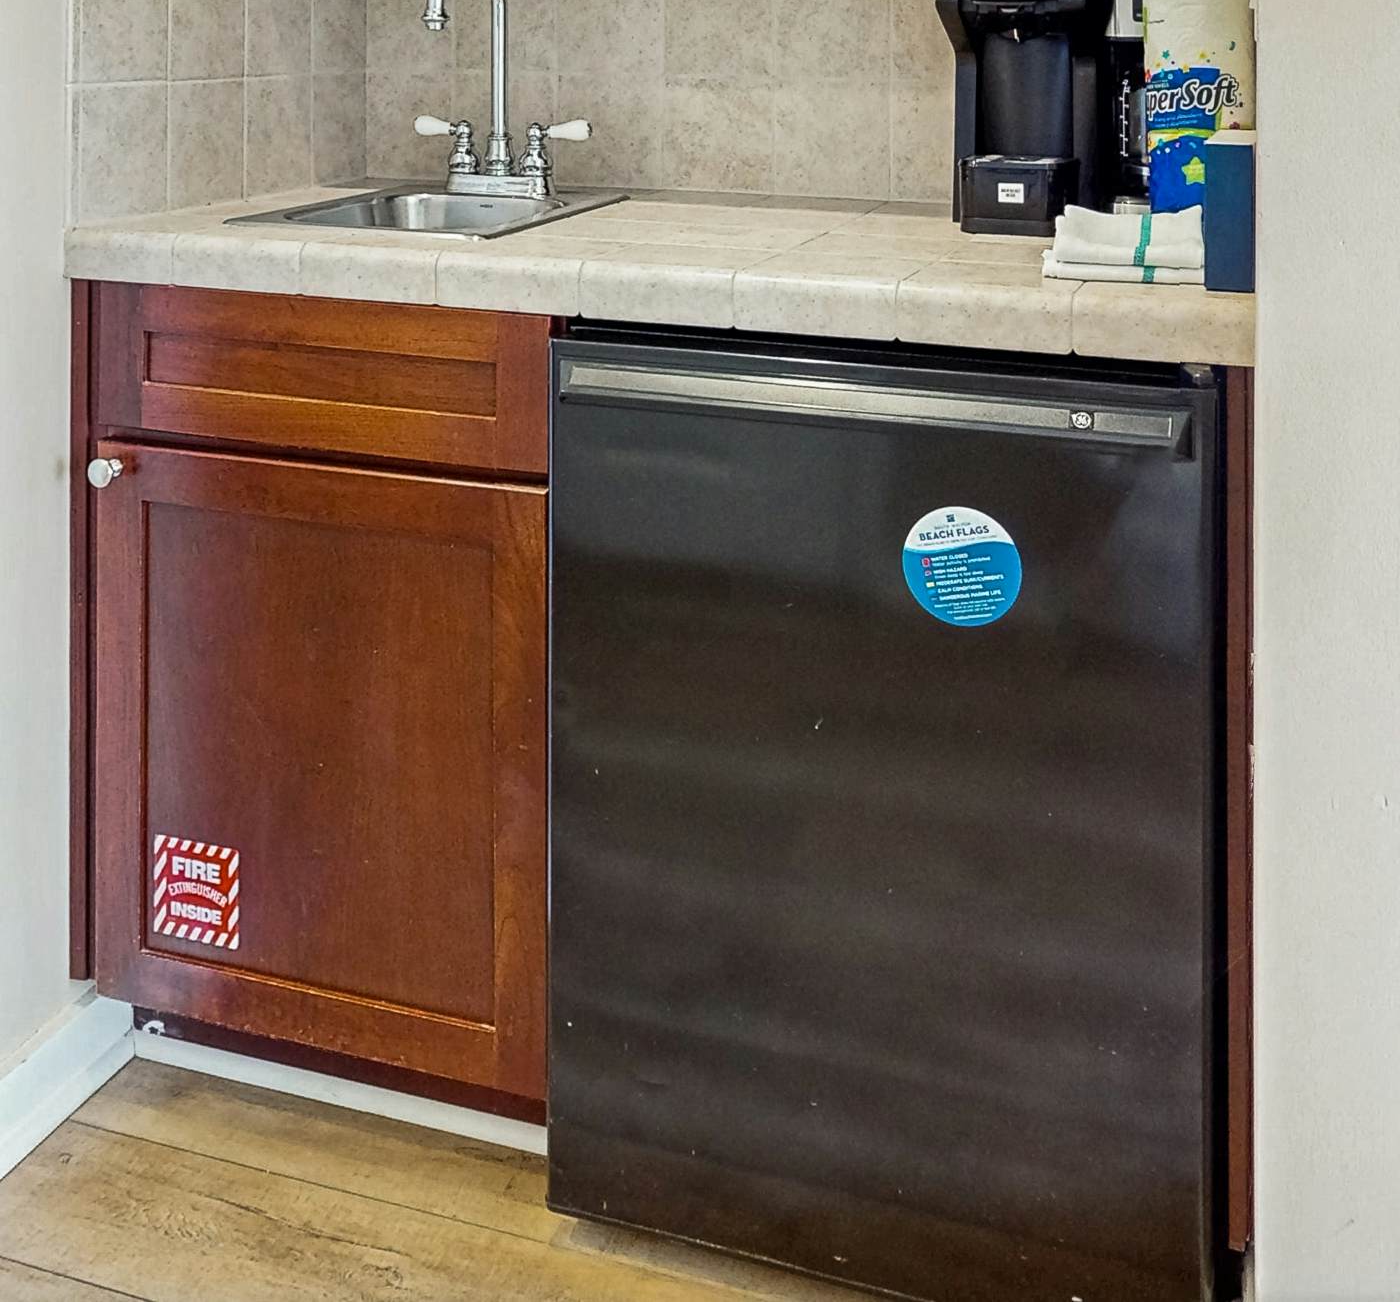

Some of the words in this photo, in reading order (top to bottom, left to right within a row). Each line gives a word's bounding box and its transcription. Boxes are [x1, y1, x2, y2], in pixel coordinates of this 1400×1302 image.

[919, 529, 954, 541] BEACH
[956, 525, 990, 537] FLAGS
[172, 855, 222, 885] FIRE
[168, 881, 228, 908] EXTINGUISHER
[170, 901, 223, 926] INSIDE
